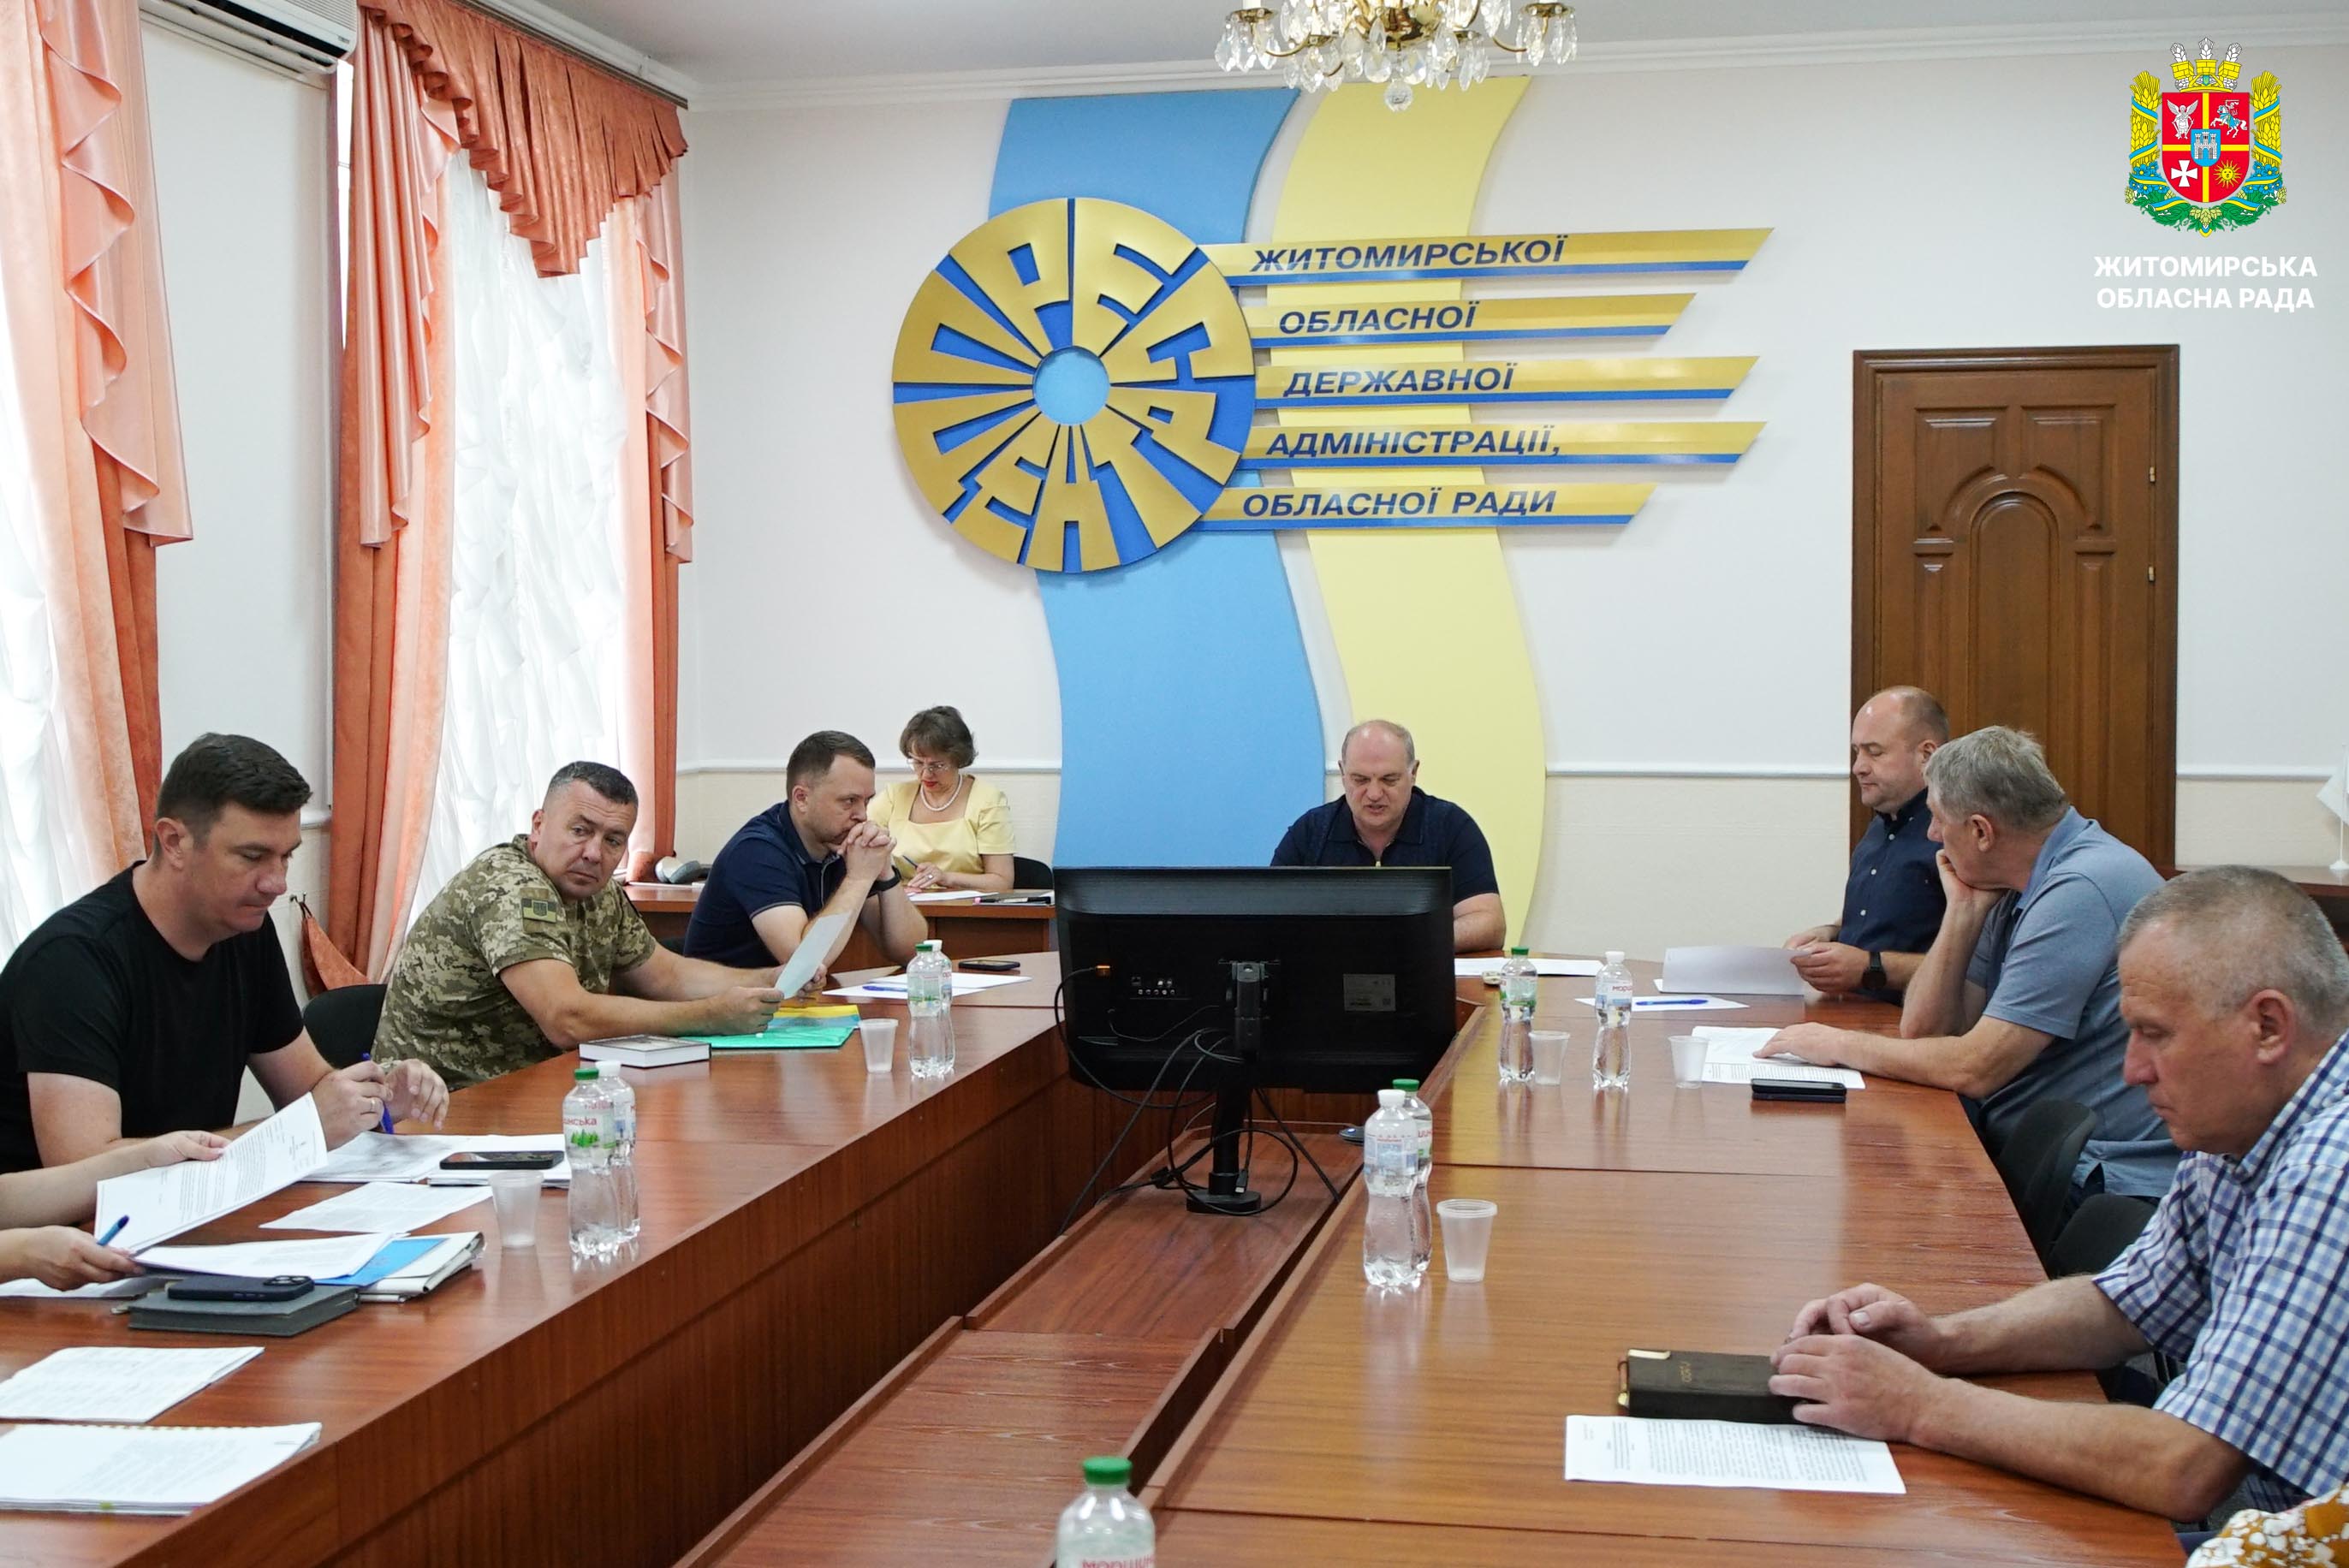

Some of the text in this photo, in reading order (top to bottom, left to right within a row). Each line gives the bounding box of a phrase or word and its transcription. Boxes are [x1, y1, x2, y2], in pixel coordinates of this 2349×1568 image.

[1249, 235, 1568, 273] ЖИТОМИРСЬКОЇ
[1279, 300, 1481, 335] ОБЛАСНОЇ
[1283, 362, 1519, 398] ДЕРЖАВНОЇ
[1265, 425, 1561, 458] АДМІНІСТРАЦІЇ,
[1242, 487, 1556, 517] ОБЛАСНОЇ РАДИ
